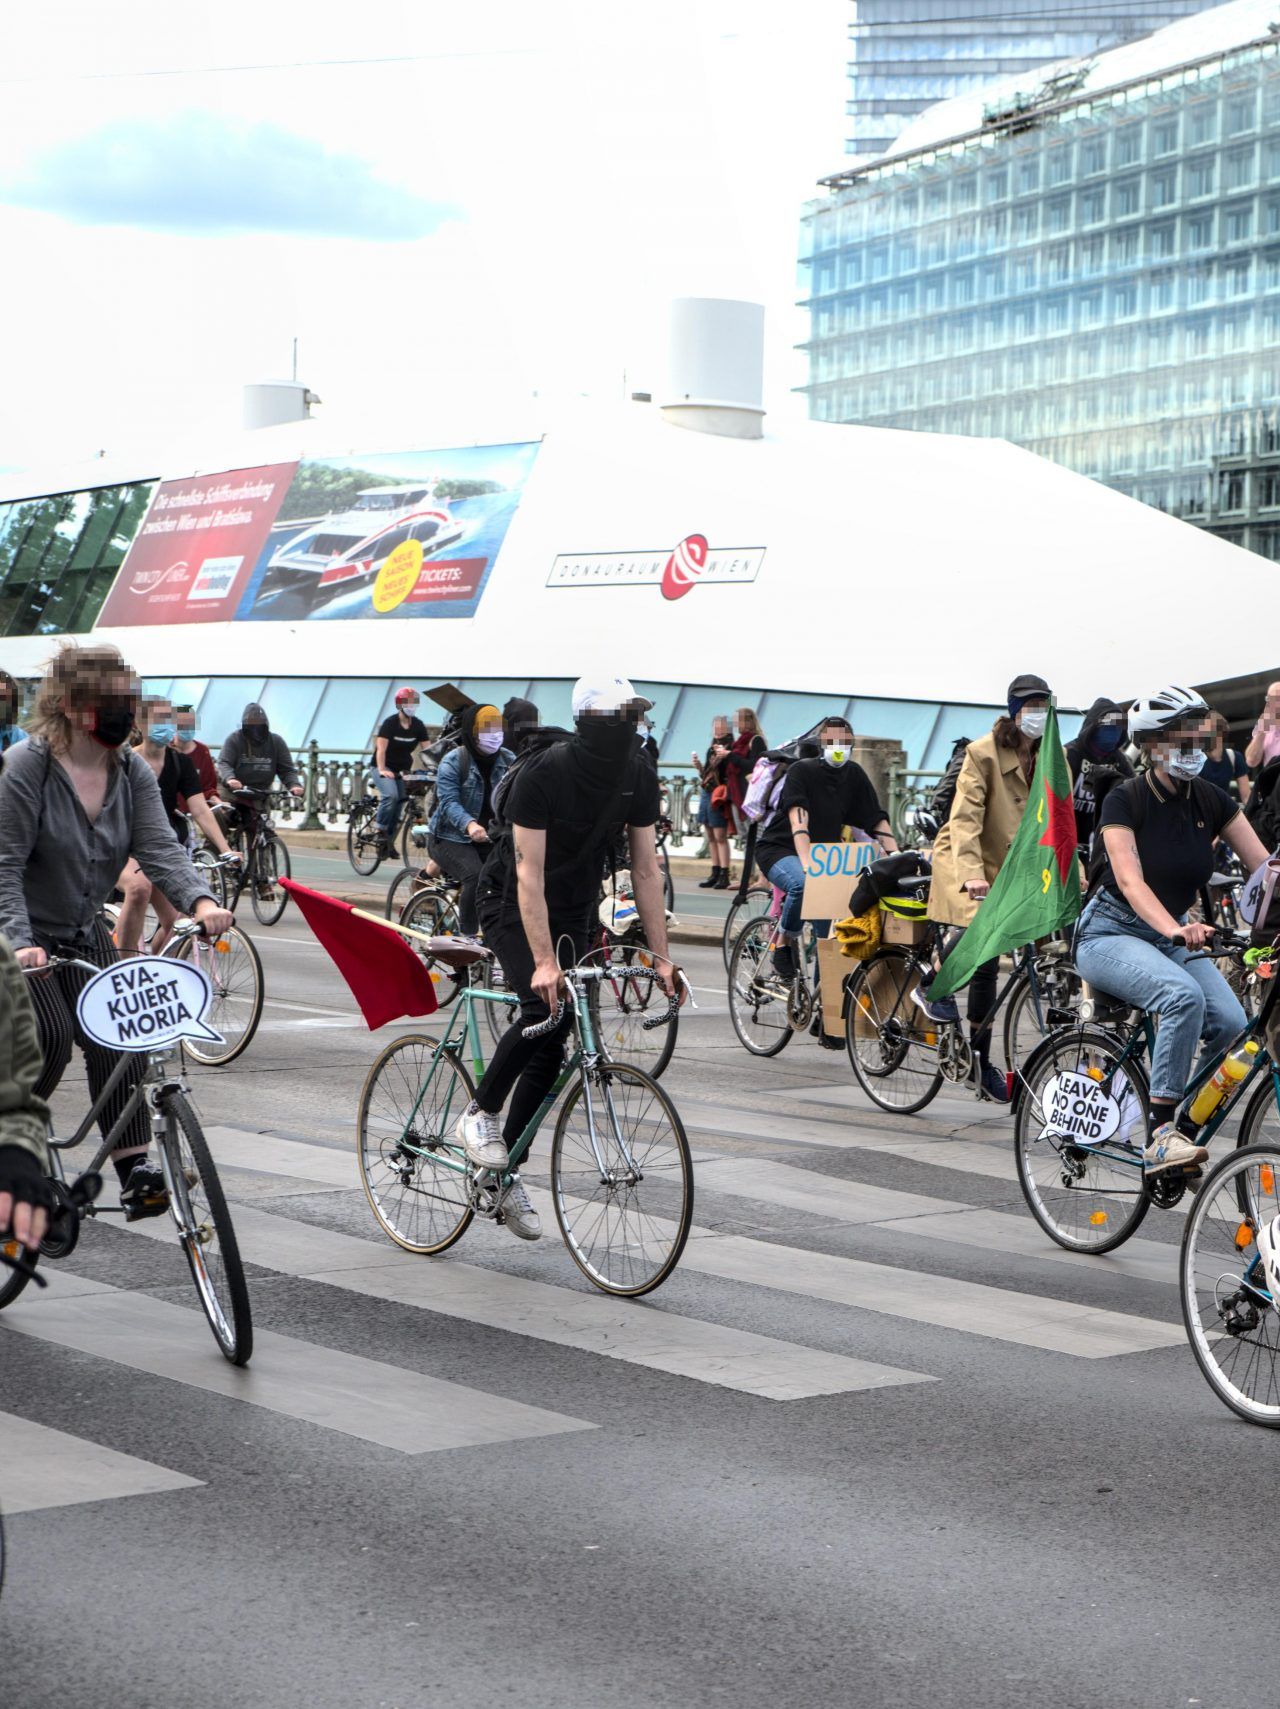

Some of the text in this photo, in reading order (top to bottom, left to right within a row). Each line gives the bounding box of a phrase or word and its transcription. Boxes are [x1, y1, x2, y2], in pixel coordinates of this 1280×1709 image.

[419, 567, 463, 583] TICKETS:
[560, 559, 750, 577] DONAURAUM WIEN
[808, 843, 881, 878] SOLID
[111, 966, 159, 995] EVA-
[107, 980, 179, 1021] KUIERT
[118, 1002, 192, 1042] MORIA
[1059, 1076, 1100, 1102] LEAVE
[1052, 1090, 1109, 1122] NO ONE
[1050, 1109, 1102, 1138] BEHIND
